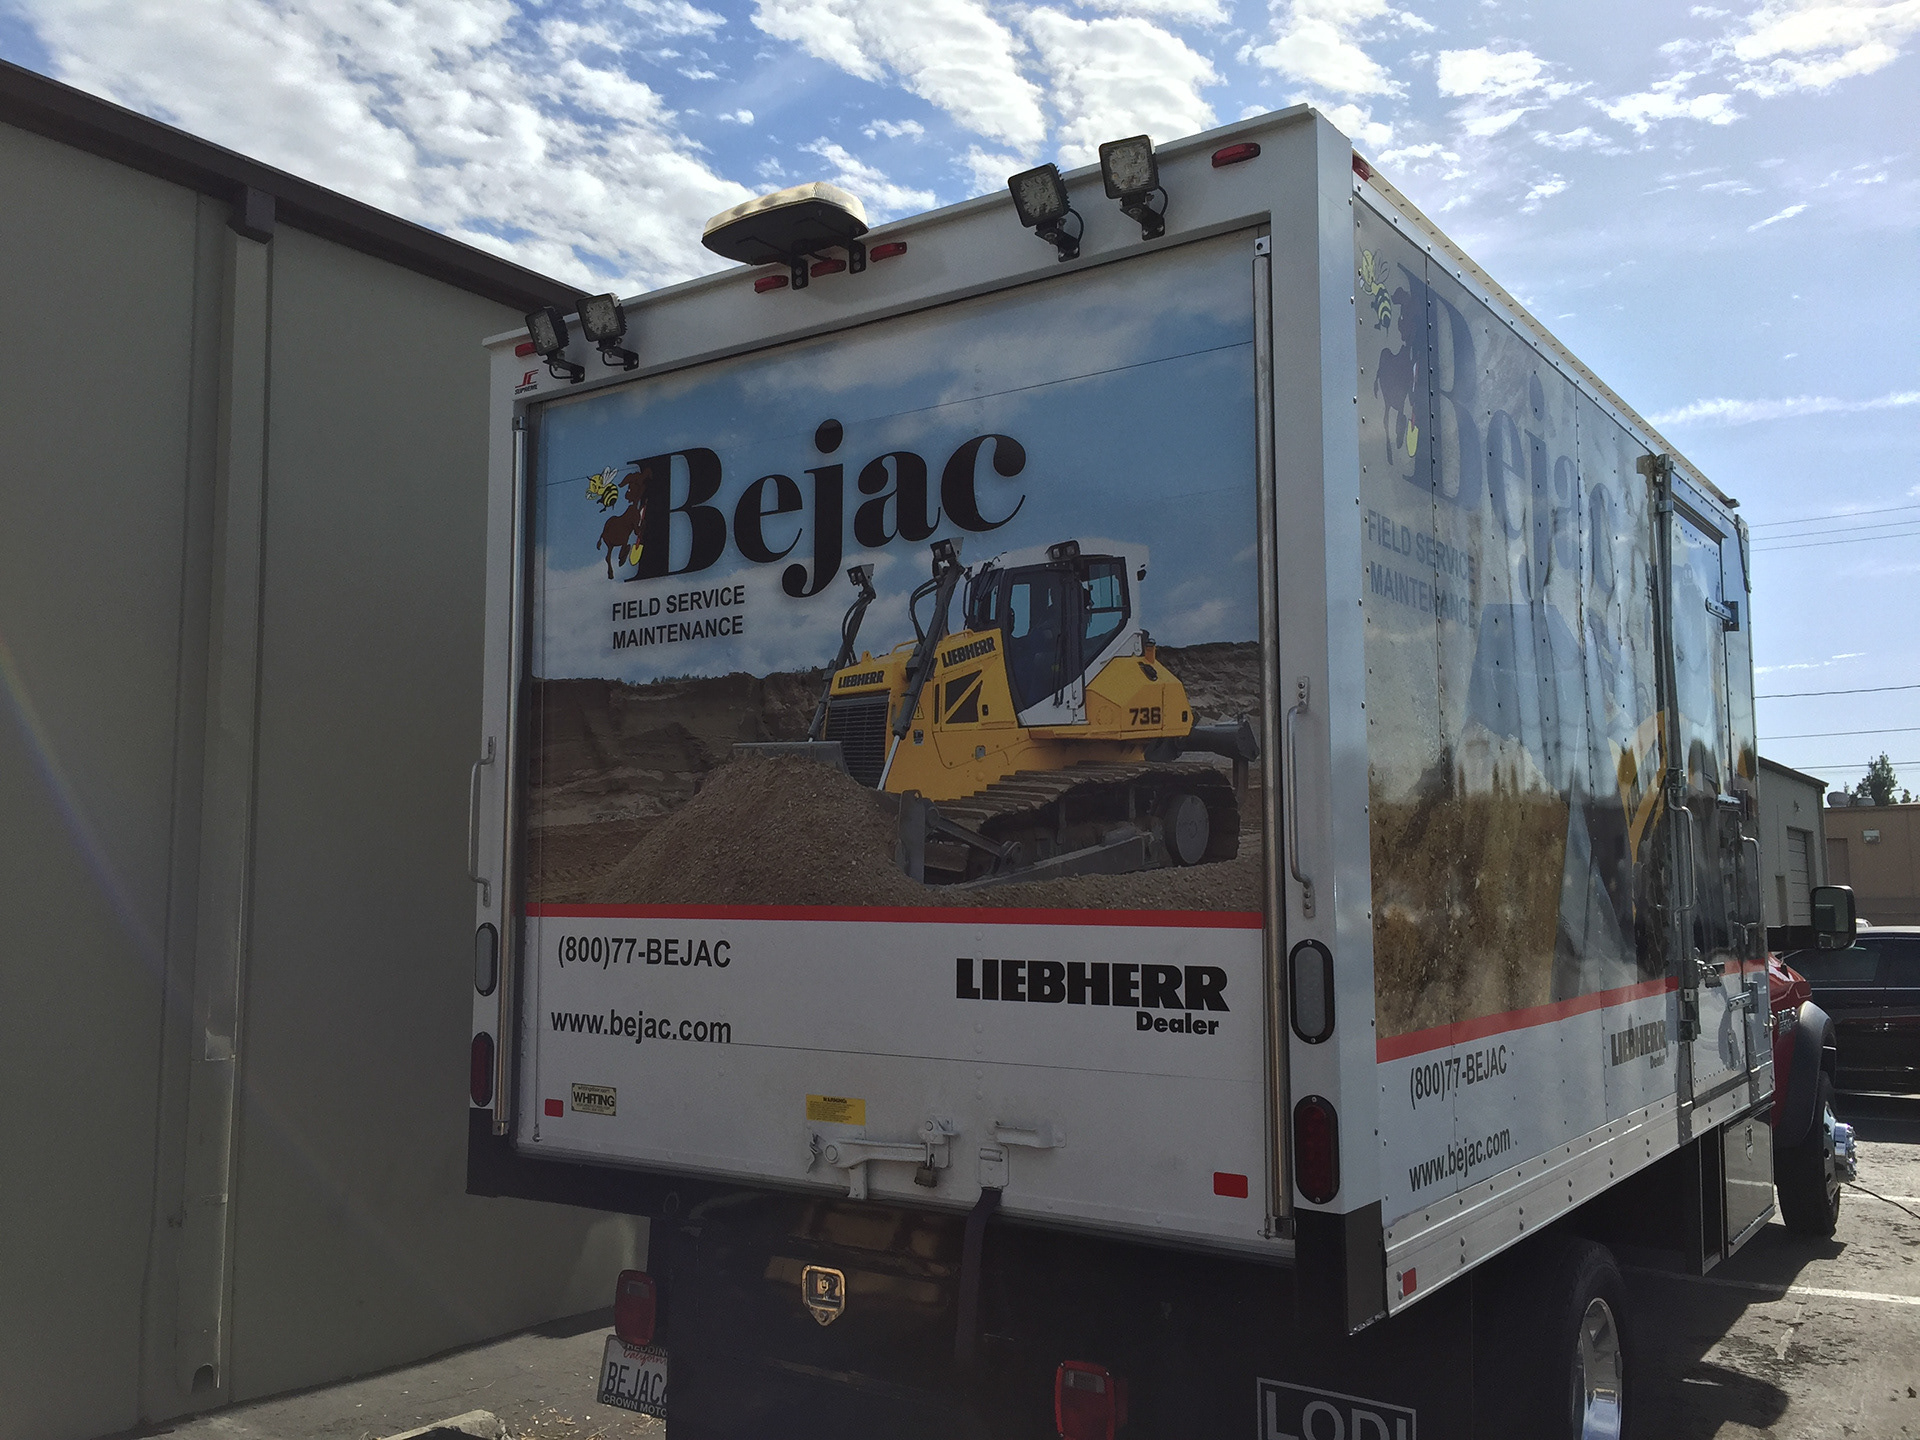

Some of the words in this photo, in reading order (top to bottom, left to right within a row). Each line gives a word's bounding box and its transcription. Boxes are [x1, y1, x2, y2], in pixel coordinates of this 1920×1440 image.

[624, 419, 1027, 597] Bejac
[1368, 509, 1411, 557] FIELD
[1416, 532, 1475, 584] SERVICE
[612, 594, 661, 622] FIELD
[666, 585, 745, 615] SERVICE
[1370, 561, 1476, 629] MAINTENANCE
[612, 615, 744, 650] MAINTENANCE
[942, 637, 996, 668] LIEBHERR
[838, 670, 885, 690] LIEBHERR
[1129, 706, 1162, 726] 736
[558, 935, 732, 970] (800)77-BEJAC
[956, 958, 1231, 1012] LIEBHERR
[550, 1009, 732, 1045] www.bejac.com
[1136, 1011, 1220, 1035] Dealer
[1611, 1020, 1667, 1066] LIEBHERR
[1409, 1044, 1507, 1109] (800)77-BEJAC
[573, 1091, 615, 1107] WHITING
[1409, 1127, 1511, 1192] www.bejac.com
[603, 1393, 638, 1410] CROWN
[1266, 1390, 1407, 1440] LODI
